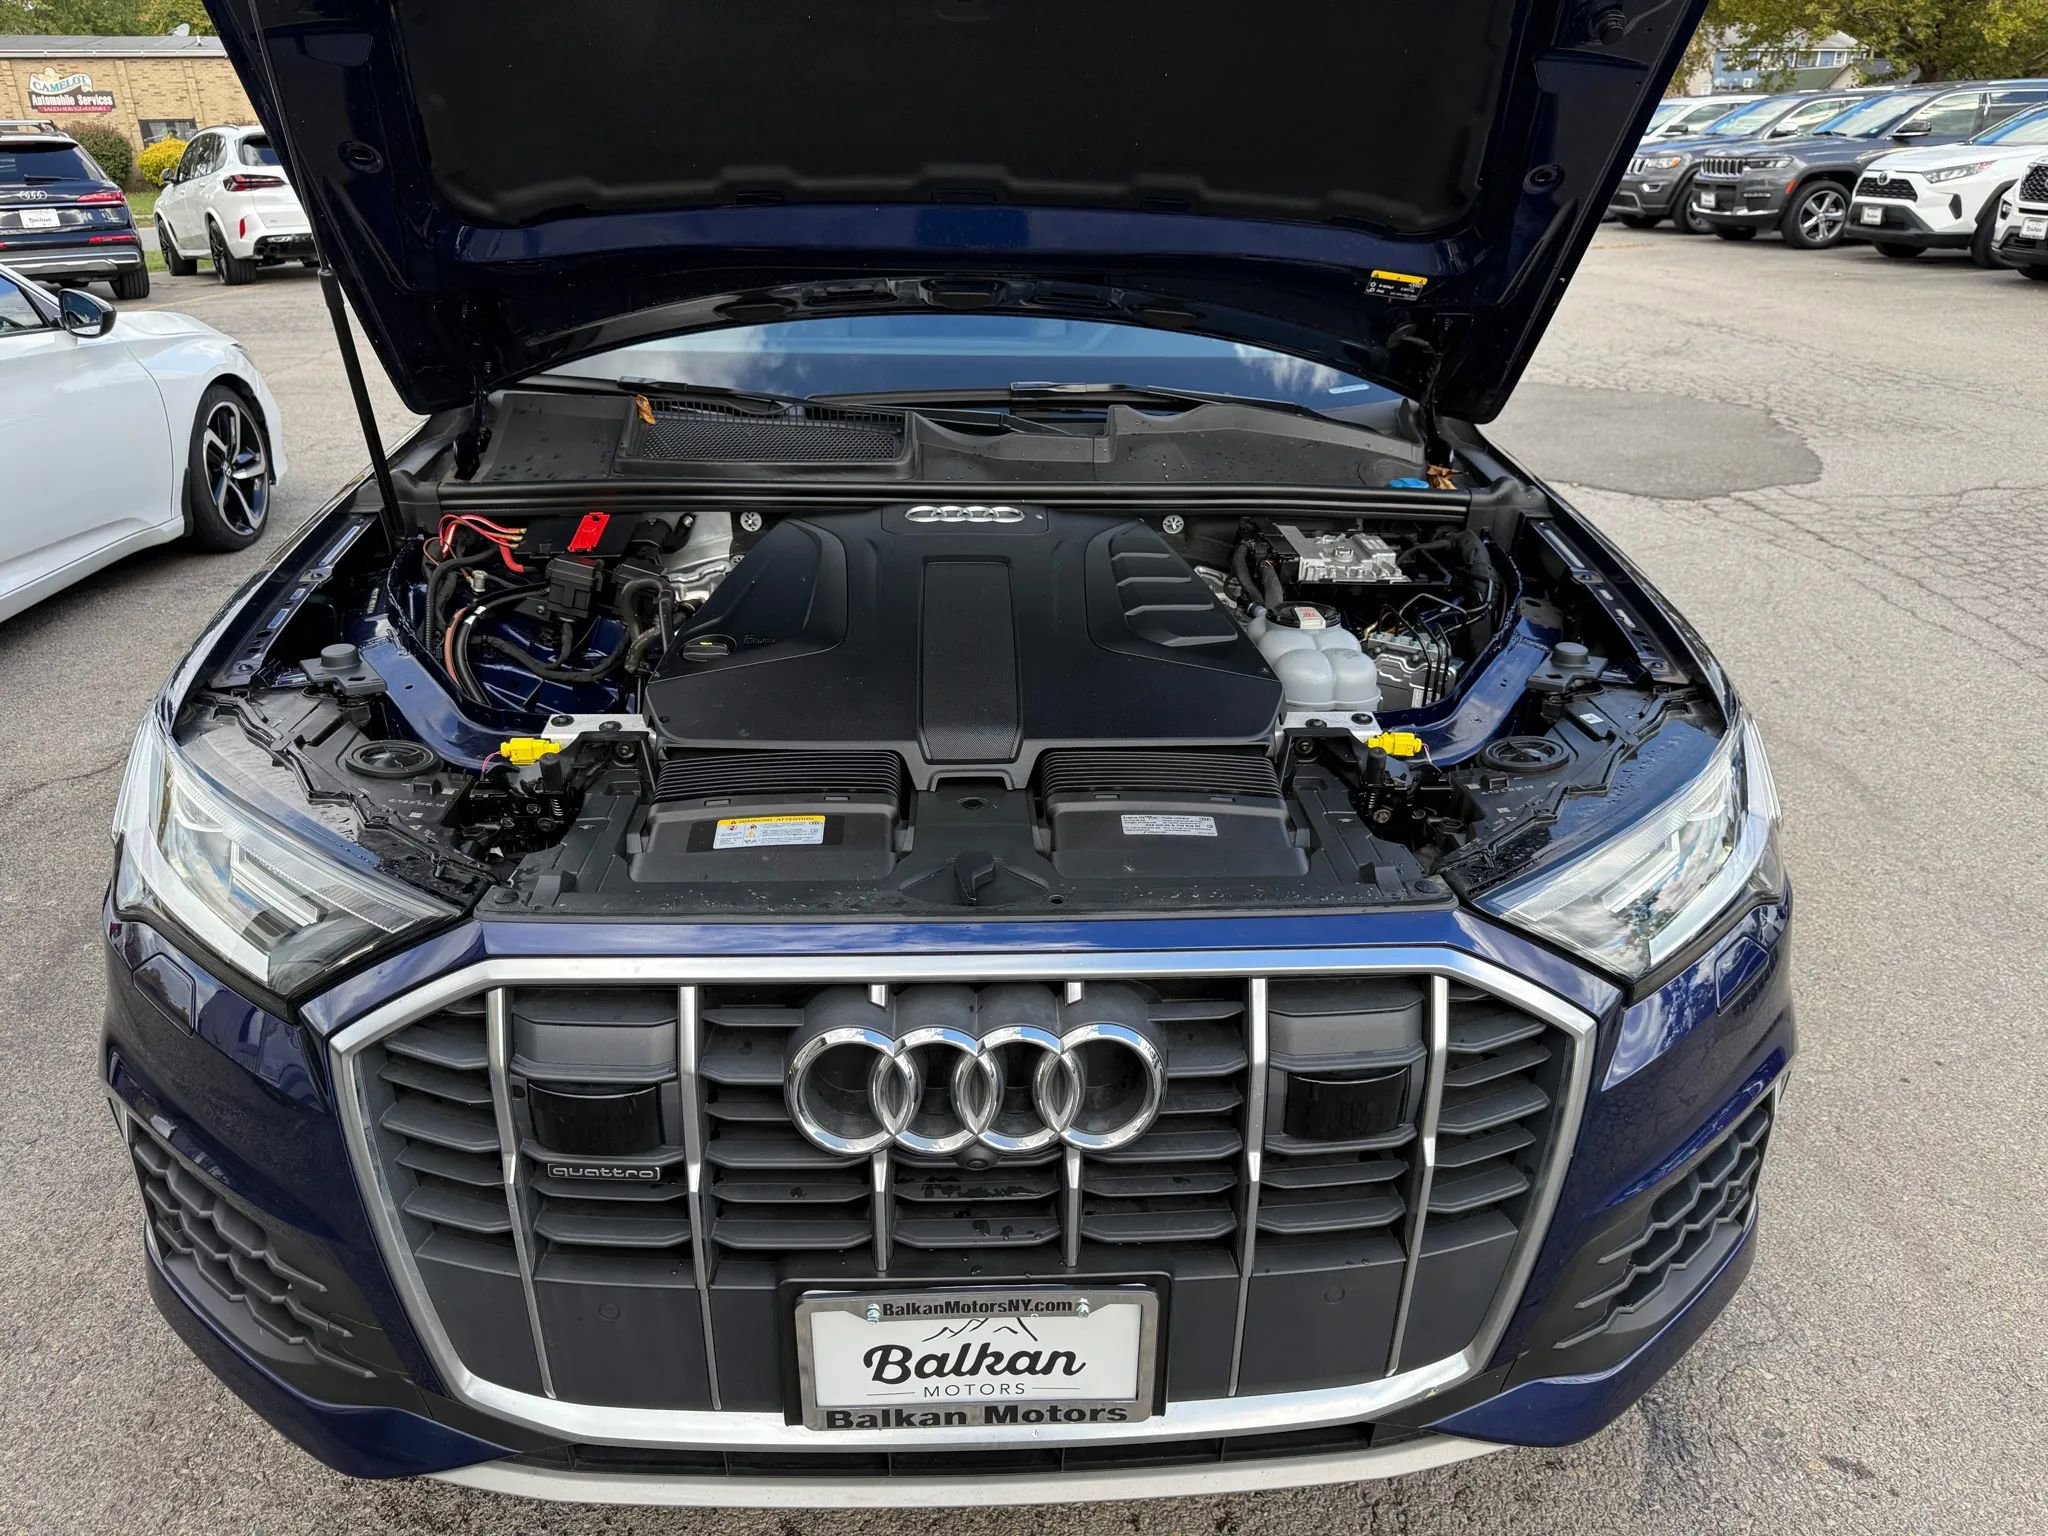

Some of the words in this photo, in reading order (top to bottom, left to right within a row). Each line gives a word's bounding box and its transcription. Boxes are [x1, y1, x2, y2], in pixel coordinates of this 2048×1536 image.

[32, 75, 88, 92] CAMELOT
[32, 94, 75, 106] Automobile
[77, 94, 113, 106] Services
[552, 1167, 654, 1178] quattro
[882, 1299, 1073, 1316] BalkanMotorsNY.com
[863, 1342, 1087, 1385] Balkan
[923, 1383, 1026, 1398] MOTORS
[826, 1408, 968, 1430] Balkan
[984, 1405, 1128, 1425] Motors
